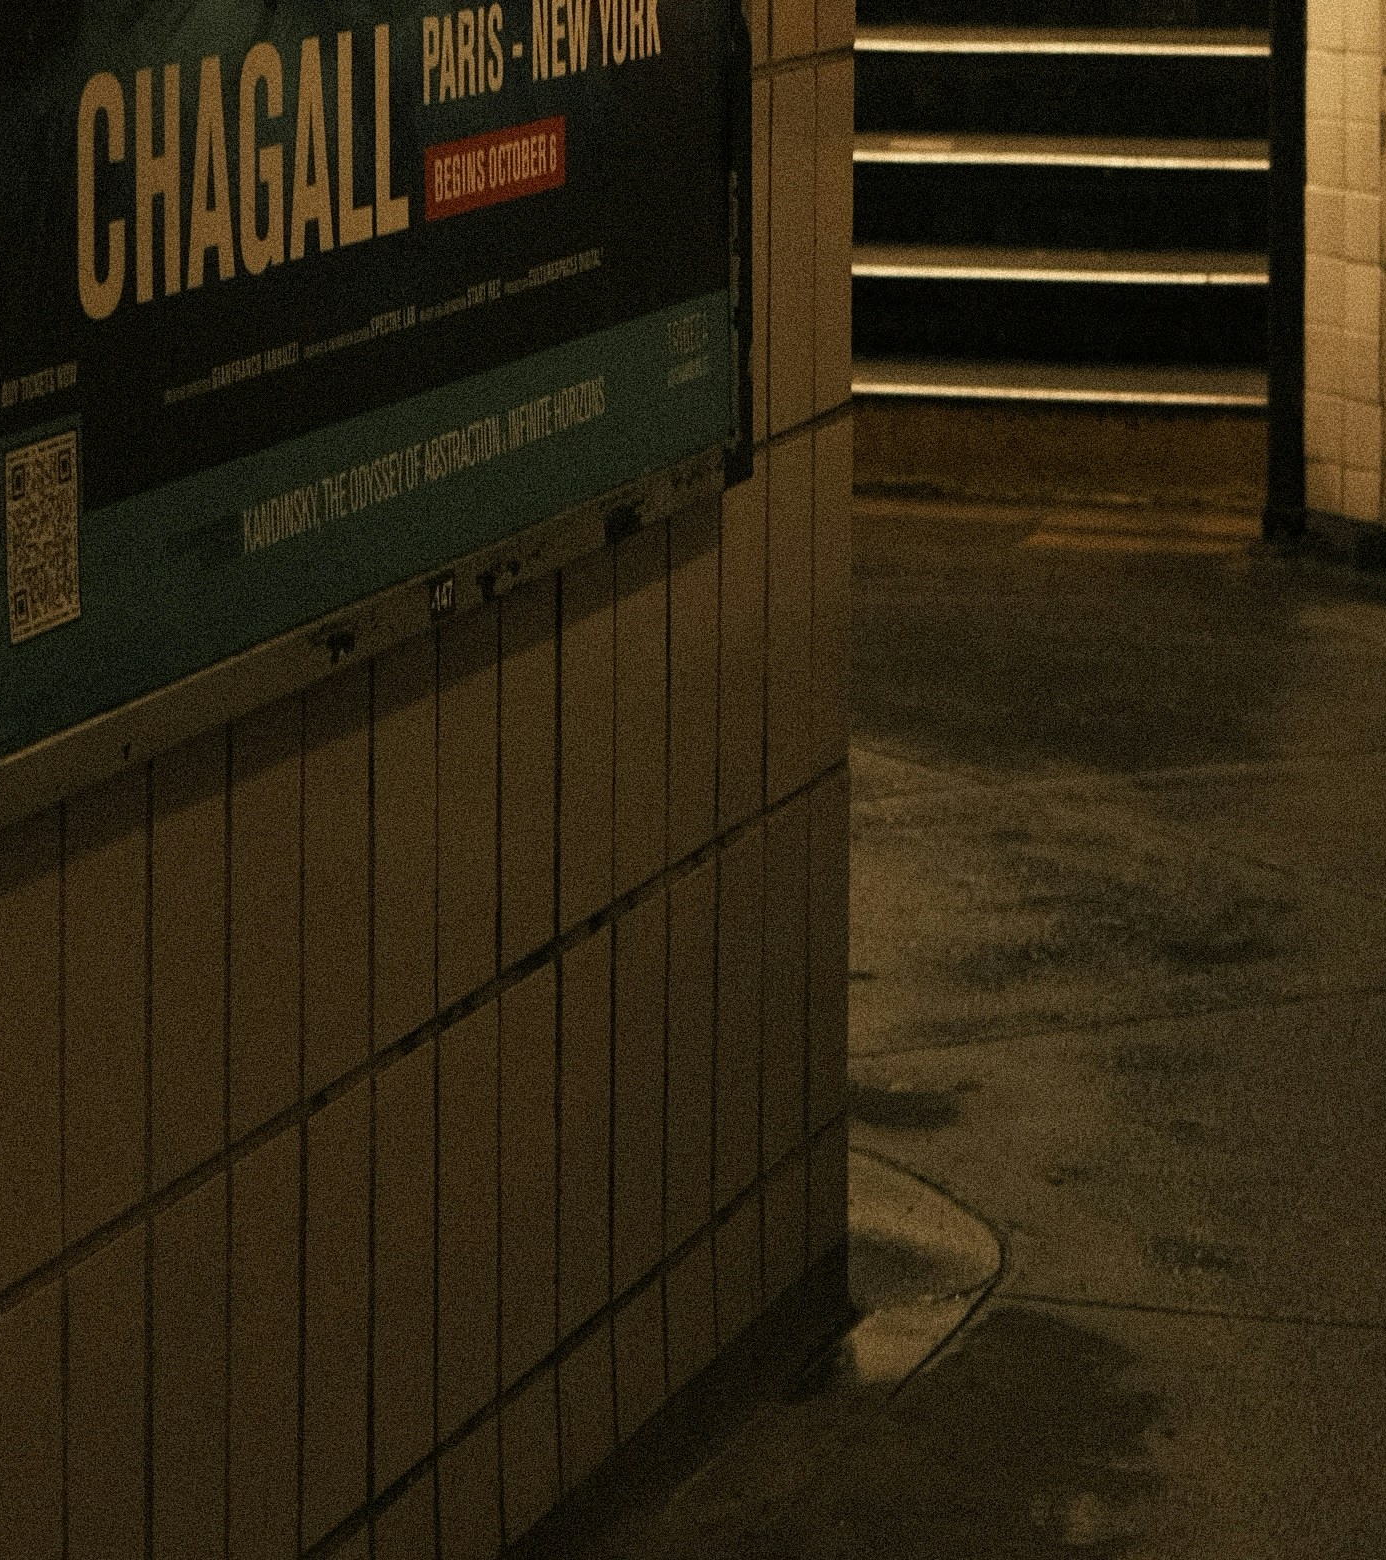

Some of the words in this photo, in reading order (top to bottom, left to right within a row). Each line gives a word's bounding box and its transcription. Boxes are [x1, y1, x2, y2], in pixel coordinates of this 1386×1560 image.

[423, 12, 504, 105] PARIS
[77, 24, 410, 322] CHAGALL
[434, 145, 485, 204] BEGINS
[488, 136, 546, 195] OCTOBER
[548, 131, 558, 176] 6
[321, 471, 348, 522] THE
[348, 449, 404, 511] ODYSSEY
[404, 444, 423, 490] OF
[507, 394, 553, 449] INFINITE
[553, 374, 606, 432] HORIZONS
